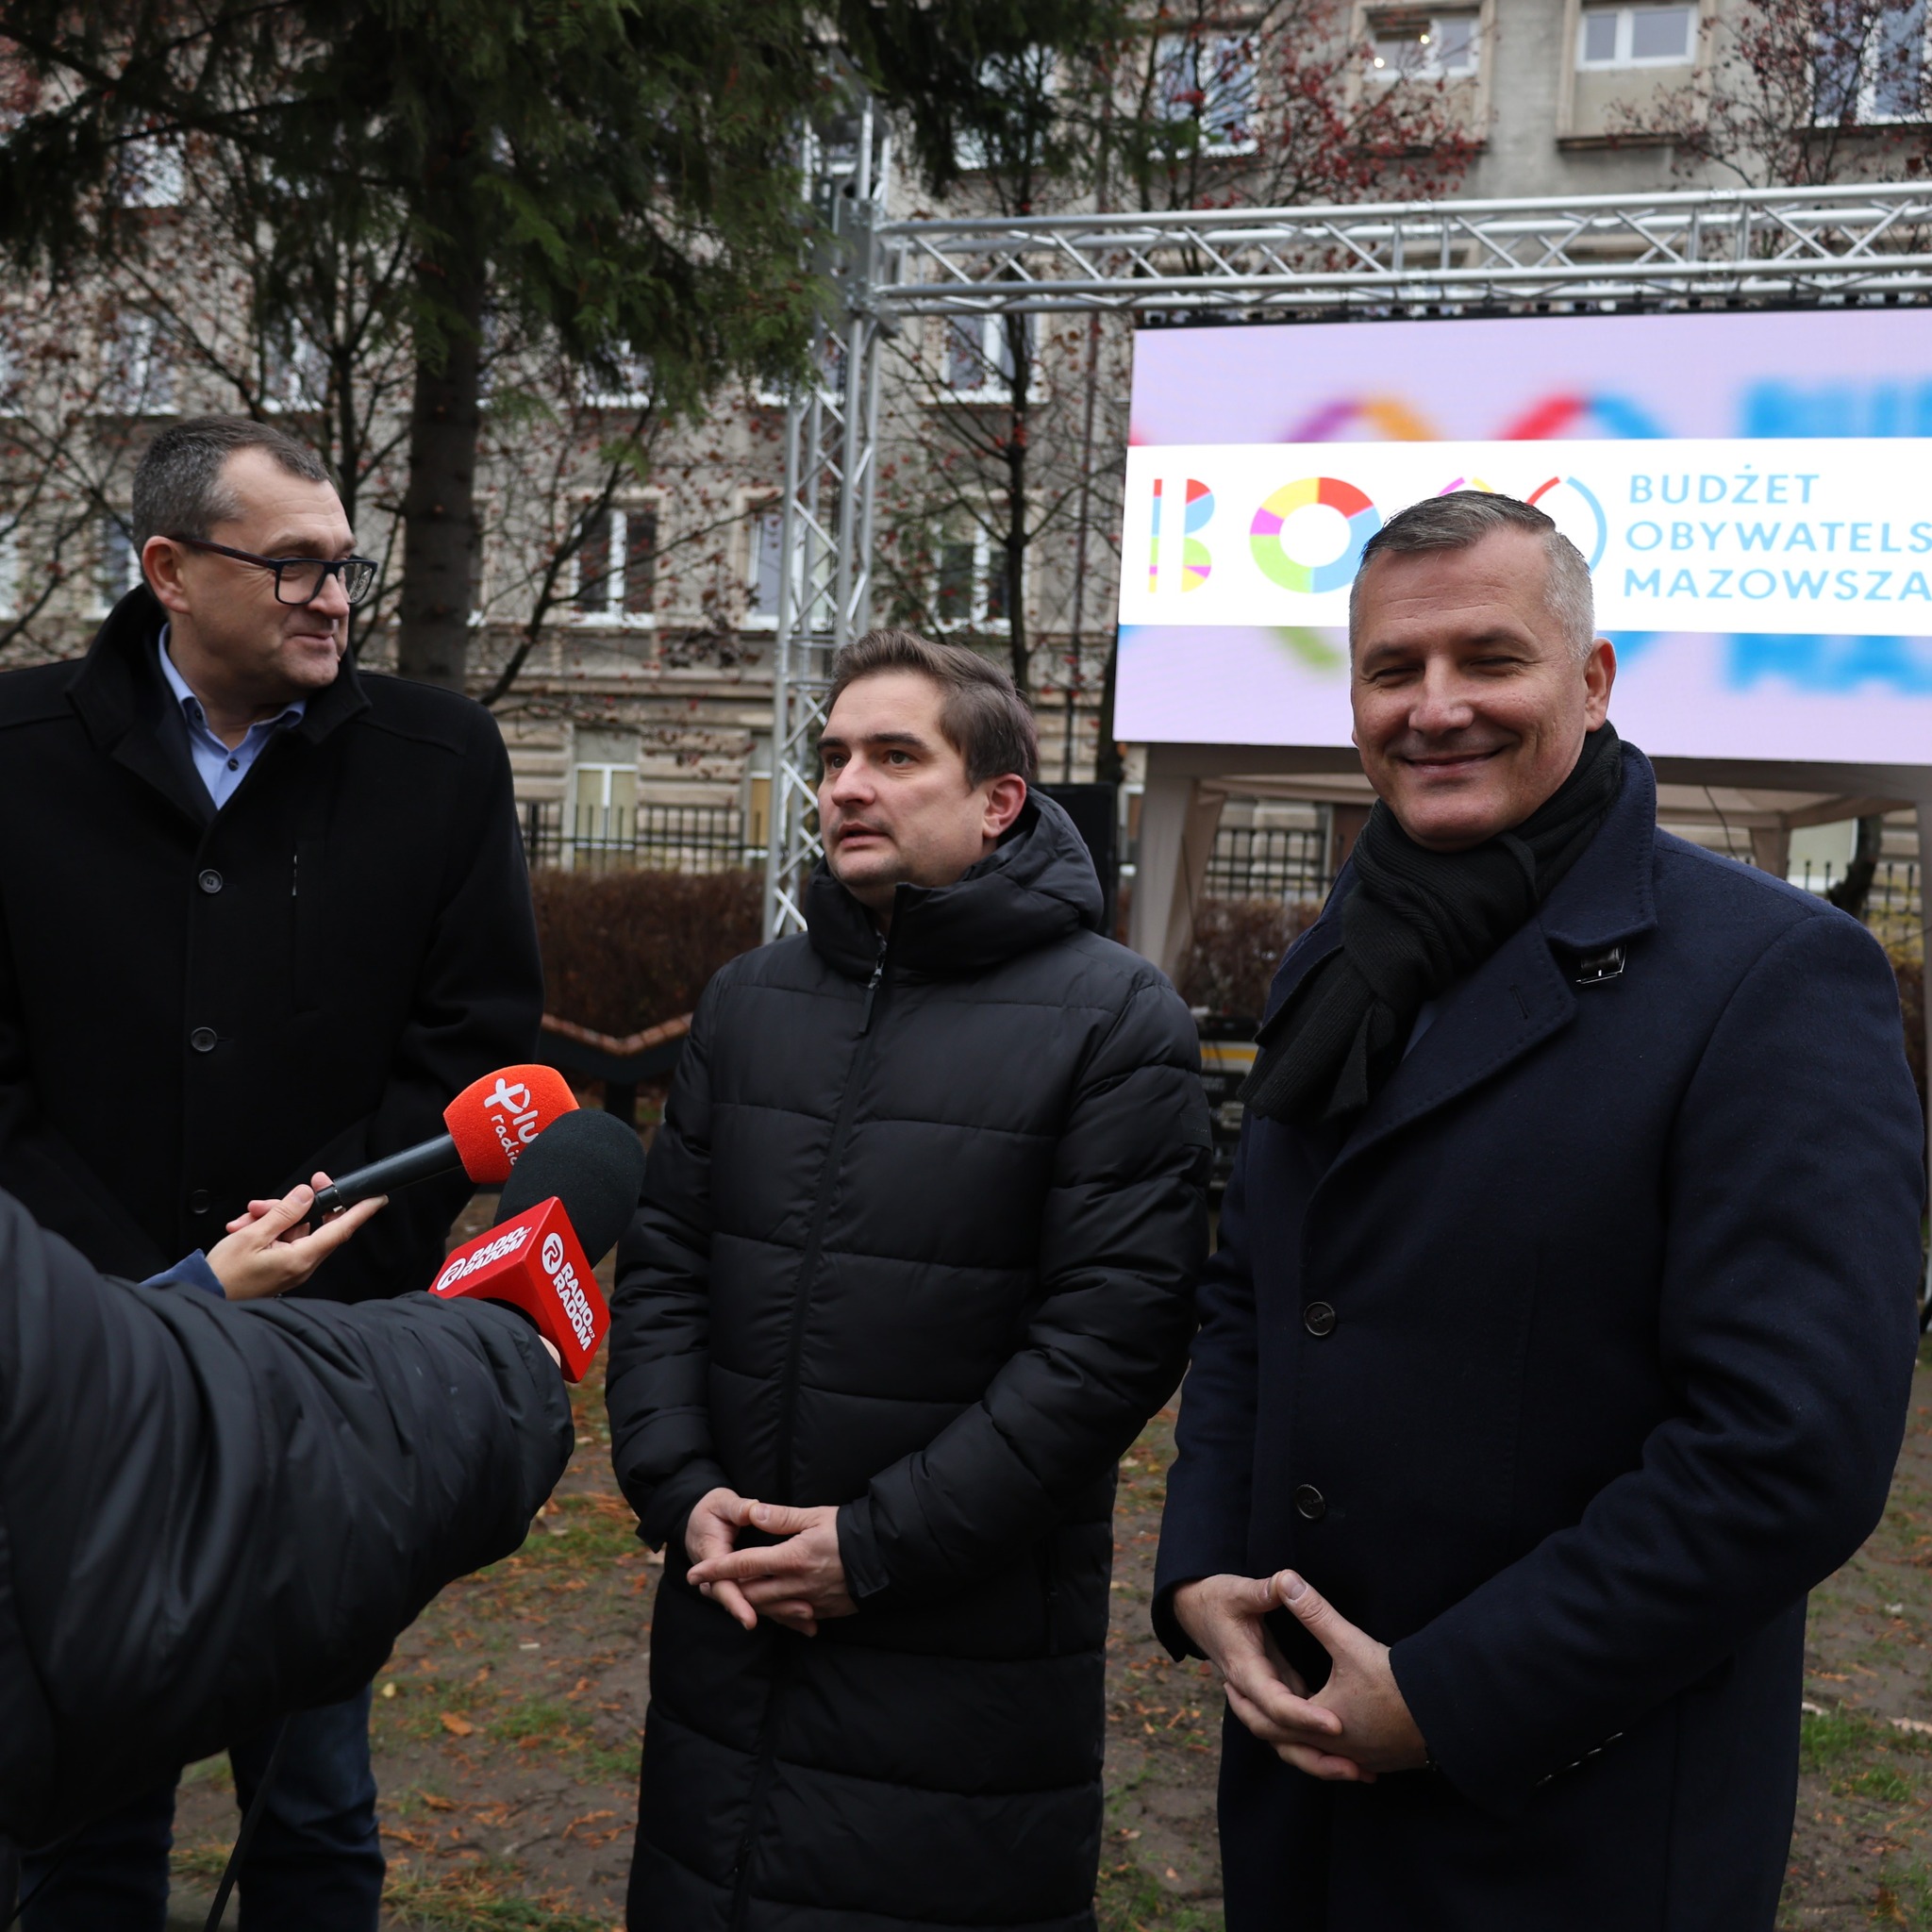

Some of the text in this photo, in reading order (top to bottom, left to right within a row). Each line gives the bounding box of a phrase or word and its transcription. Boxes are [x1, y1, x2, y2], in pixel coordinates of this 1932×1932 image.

[1629, 464, 1820, 505] BUDŻET
[1625, 521, 1932, 554] OBYWATELS
[1624, 568, 1932, 601] MAZOWSZA
[457, 1234, 527, 1281] RADOM
[466, 1226, 525, 1266] RADIO
[552, 1272, 591, 1352] RADOM
[561, 1261, 593, 1327] RADIO
